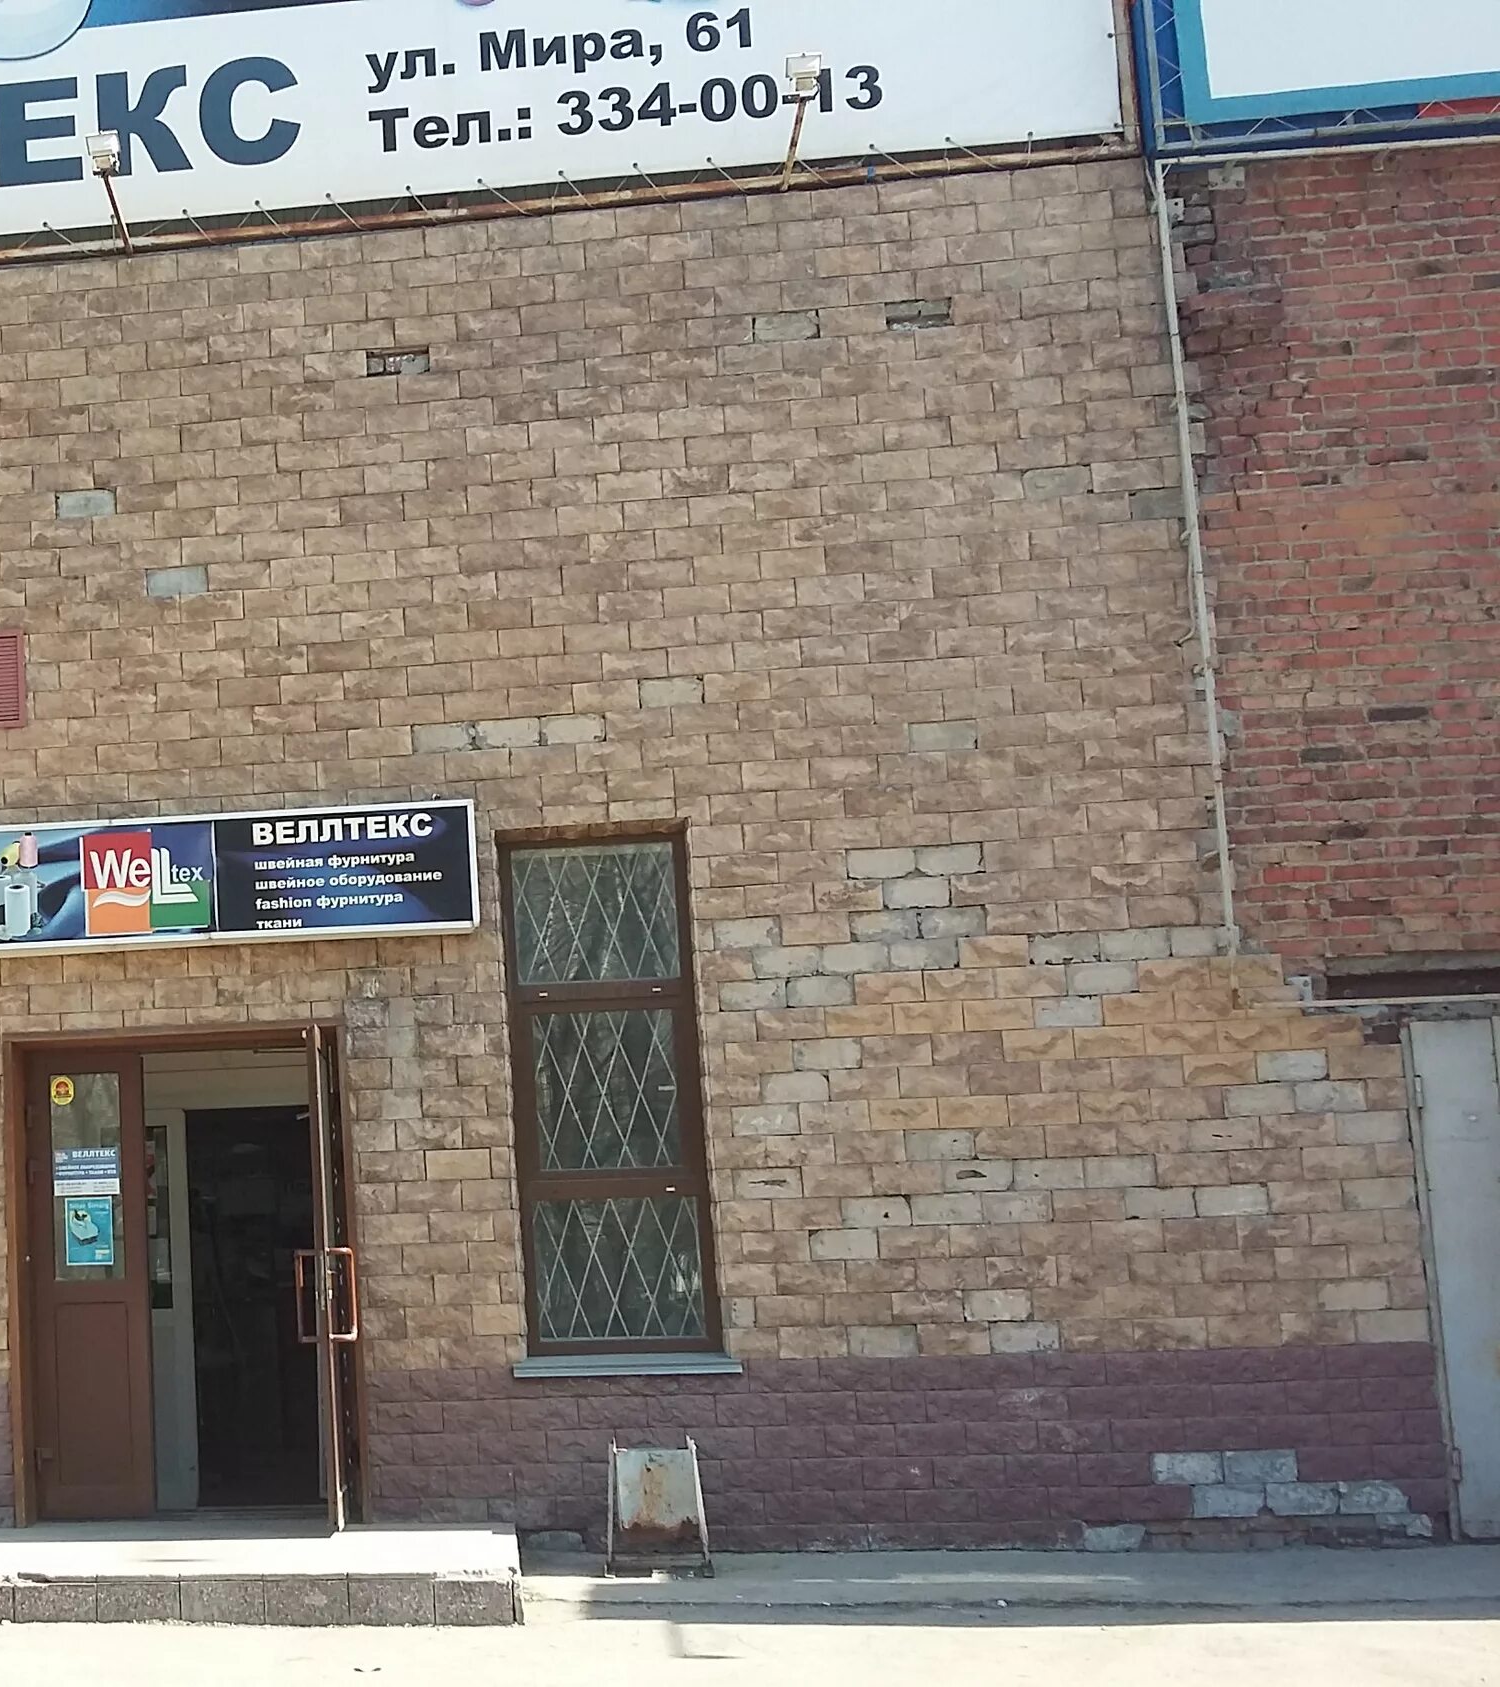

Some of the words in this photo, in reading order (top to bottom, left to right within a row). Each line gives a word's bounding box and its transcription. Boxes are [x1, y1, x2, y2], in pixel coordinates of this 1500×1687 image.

[365, 46, 455, 93] ул.
[479, 27, 663, 74] Мира,
[686, 8, 753, 52] 61
[368, 106, 533, 153] Тел.:
[557, 65, 884, 137] 334-00-13
[252, 813, 434, 846] ВЕЛЛТЕКС
[255, 856, 324, 871] швейная
[328, 852, 415, 869] фурнитура
[255, 876, 325, 890] швейное
[329, 870, 443, 887] оборудование
[255, 896, 312, 911] fashion
[316, 892, 404, 909] фурнитура
[256, 917, 303, 930] ткани
